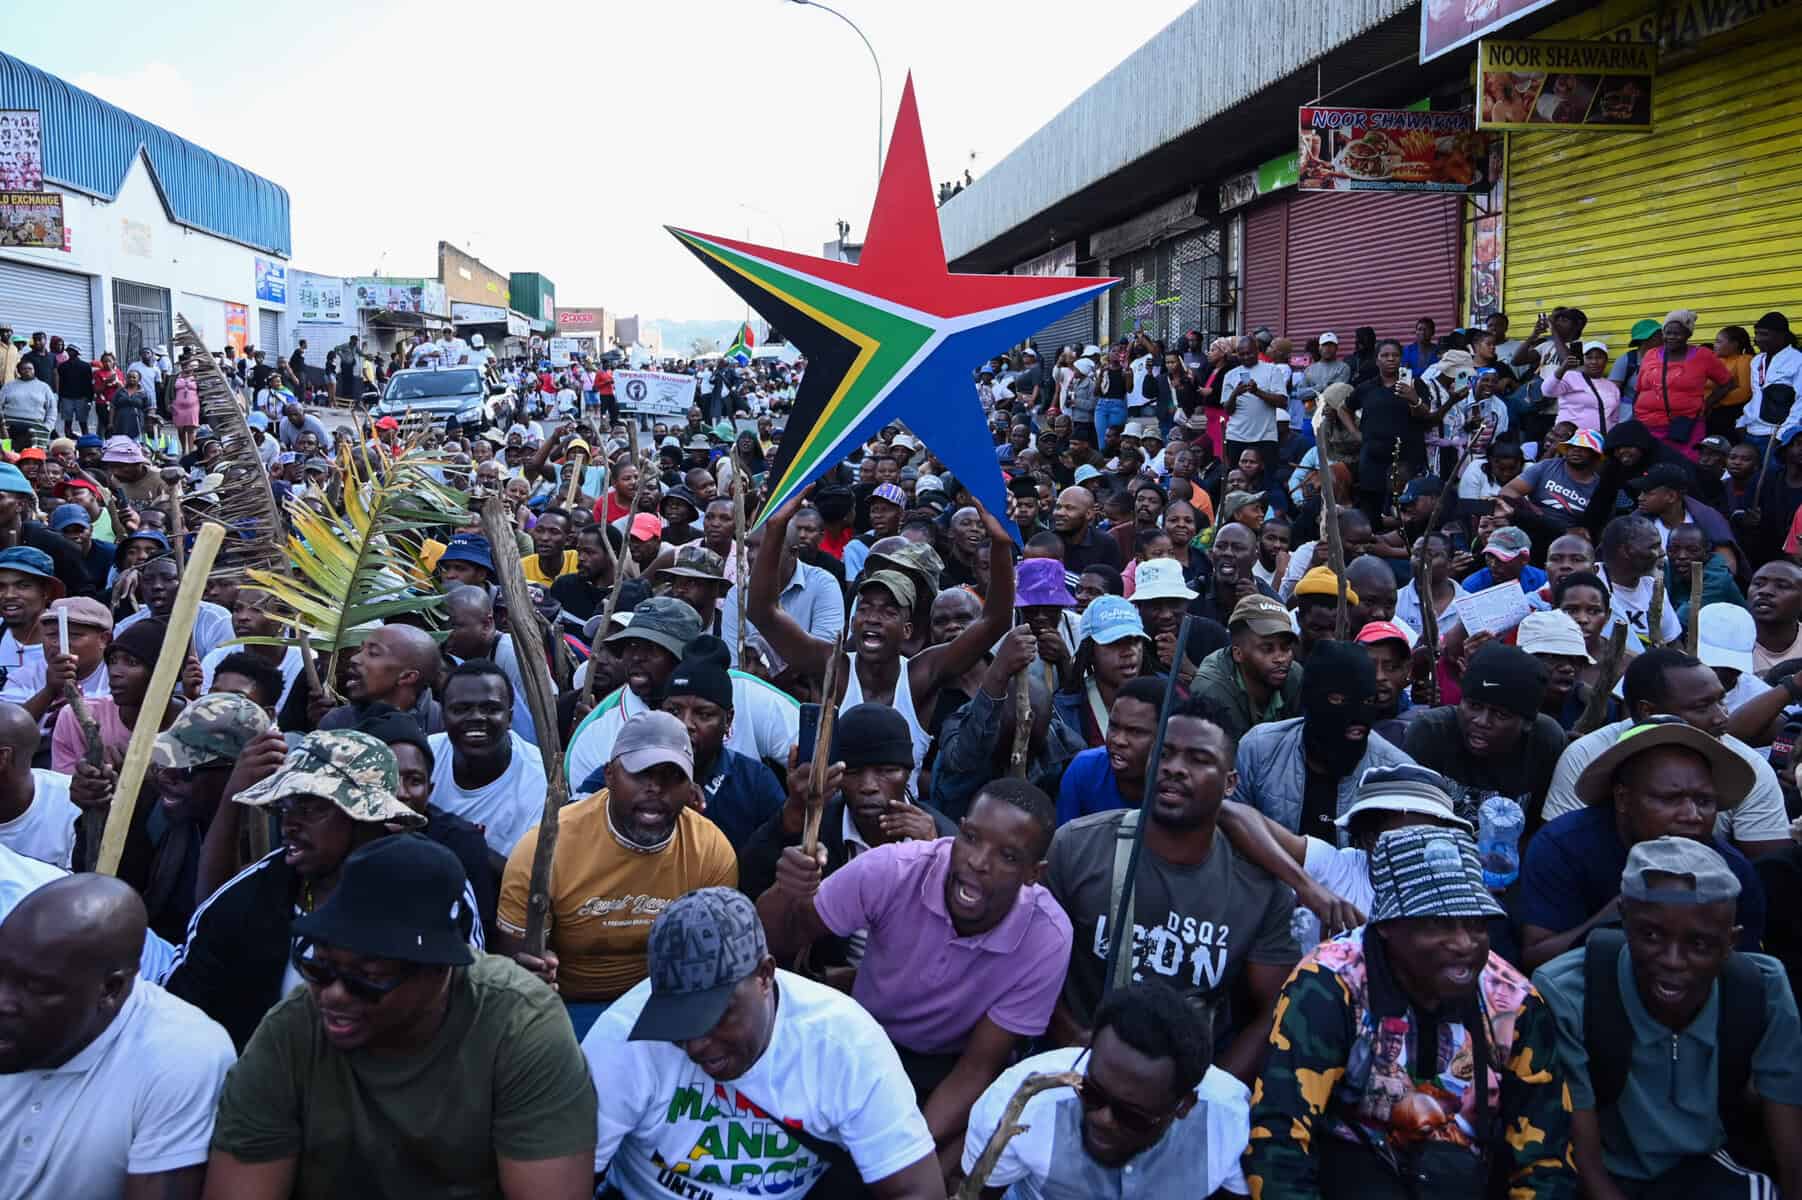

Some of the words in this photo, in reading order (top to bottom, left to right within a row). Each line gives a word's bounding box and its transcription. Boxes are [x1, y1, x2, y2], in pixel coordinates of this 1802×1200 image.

[1489, 45, 1541, 67] NOOR
[1545, 48, 1649, 69] SHAWARMA
[1312, 111, 1368, 129] NOOR
[1370, 112, 1469, 130] SHAWARMA
[11, 194, 60, 206] EXCHANGE
[1167, 910, 1230, 947] DSQ2
[665, 1082, 803, 1128] MAR
[687, 1120, 802, 1161] AND
